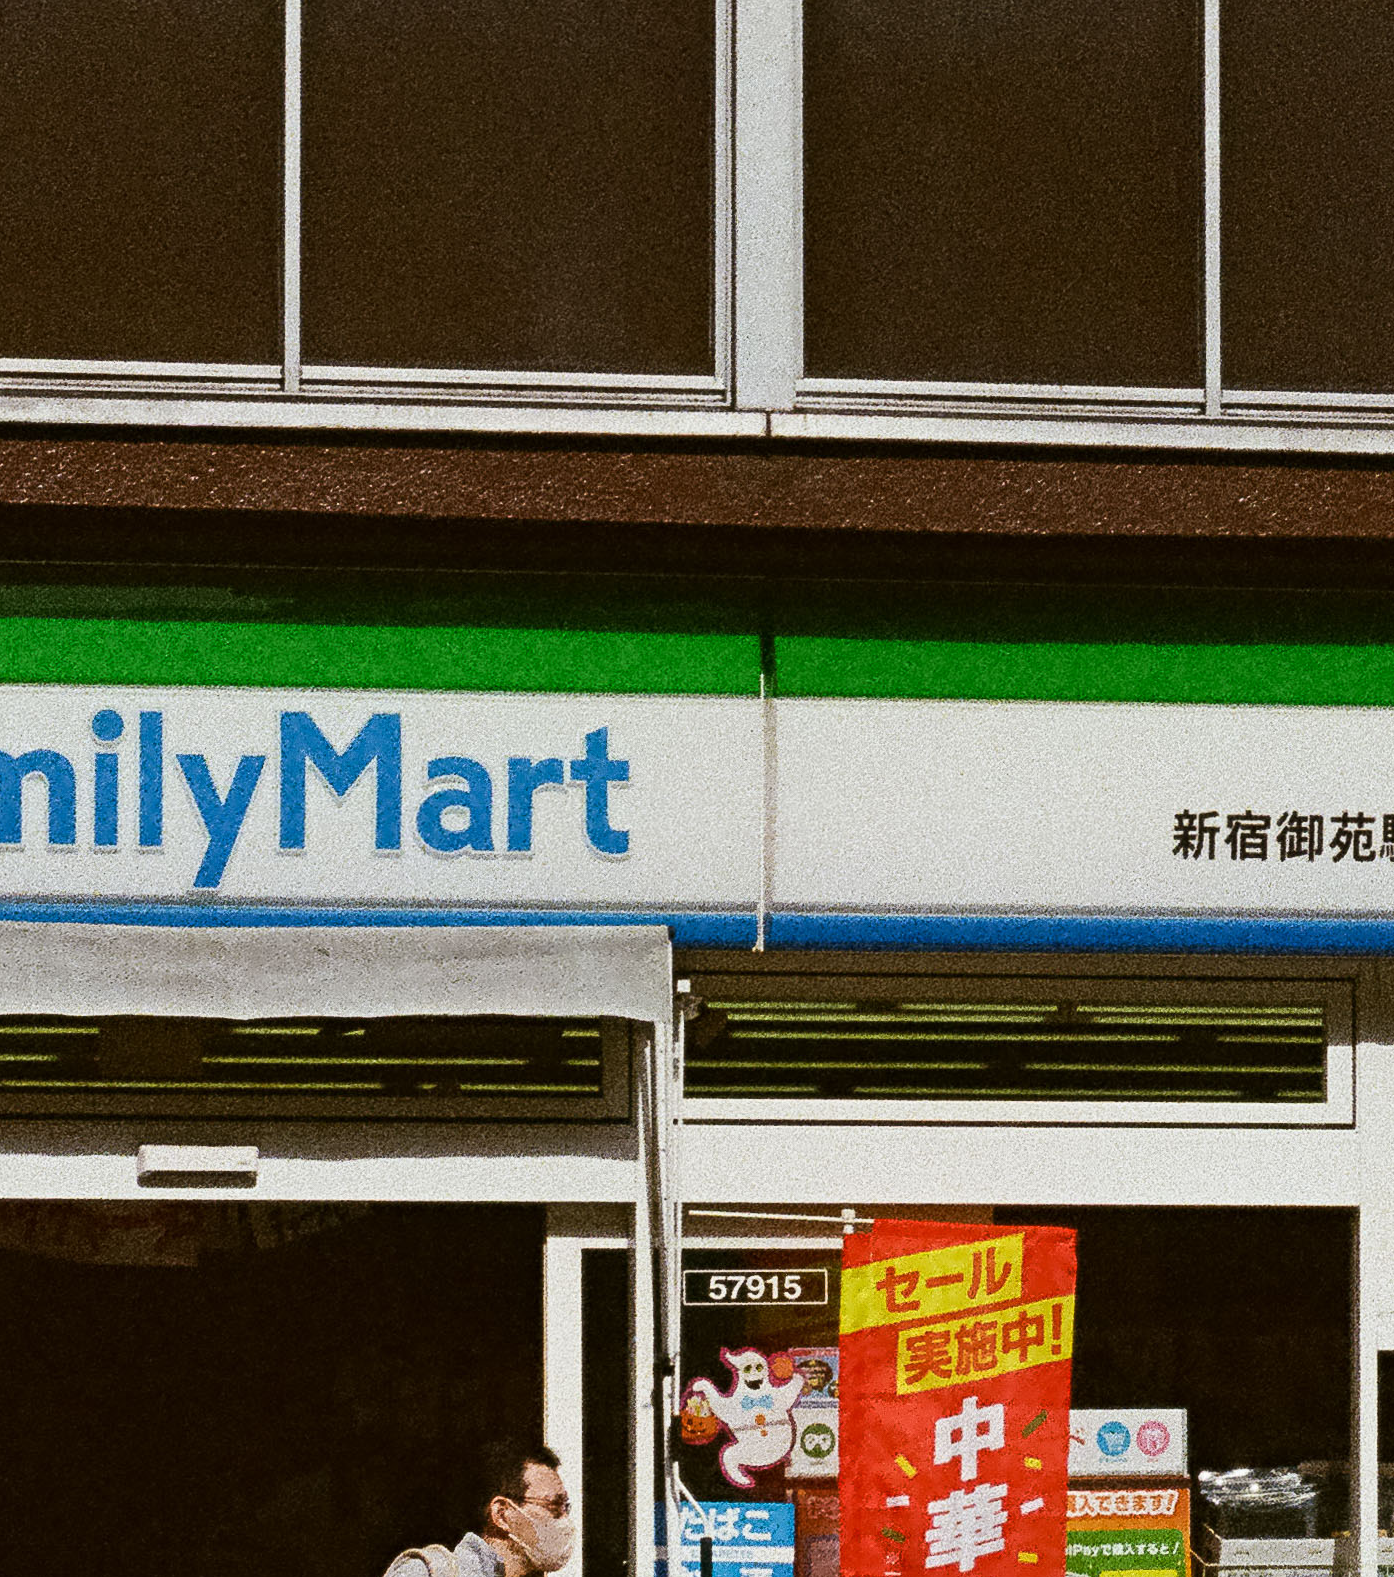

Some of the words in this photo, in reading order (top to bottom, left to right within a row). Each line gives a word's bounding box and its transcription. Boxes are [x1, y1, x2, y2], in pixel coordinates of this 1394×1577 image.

[708, 1273, 804, 1302] 57915
[877, 1245, 1013, 1315] セール
[904, 1303, 1064, 1386] 実施中!
